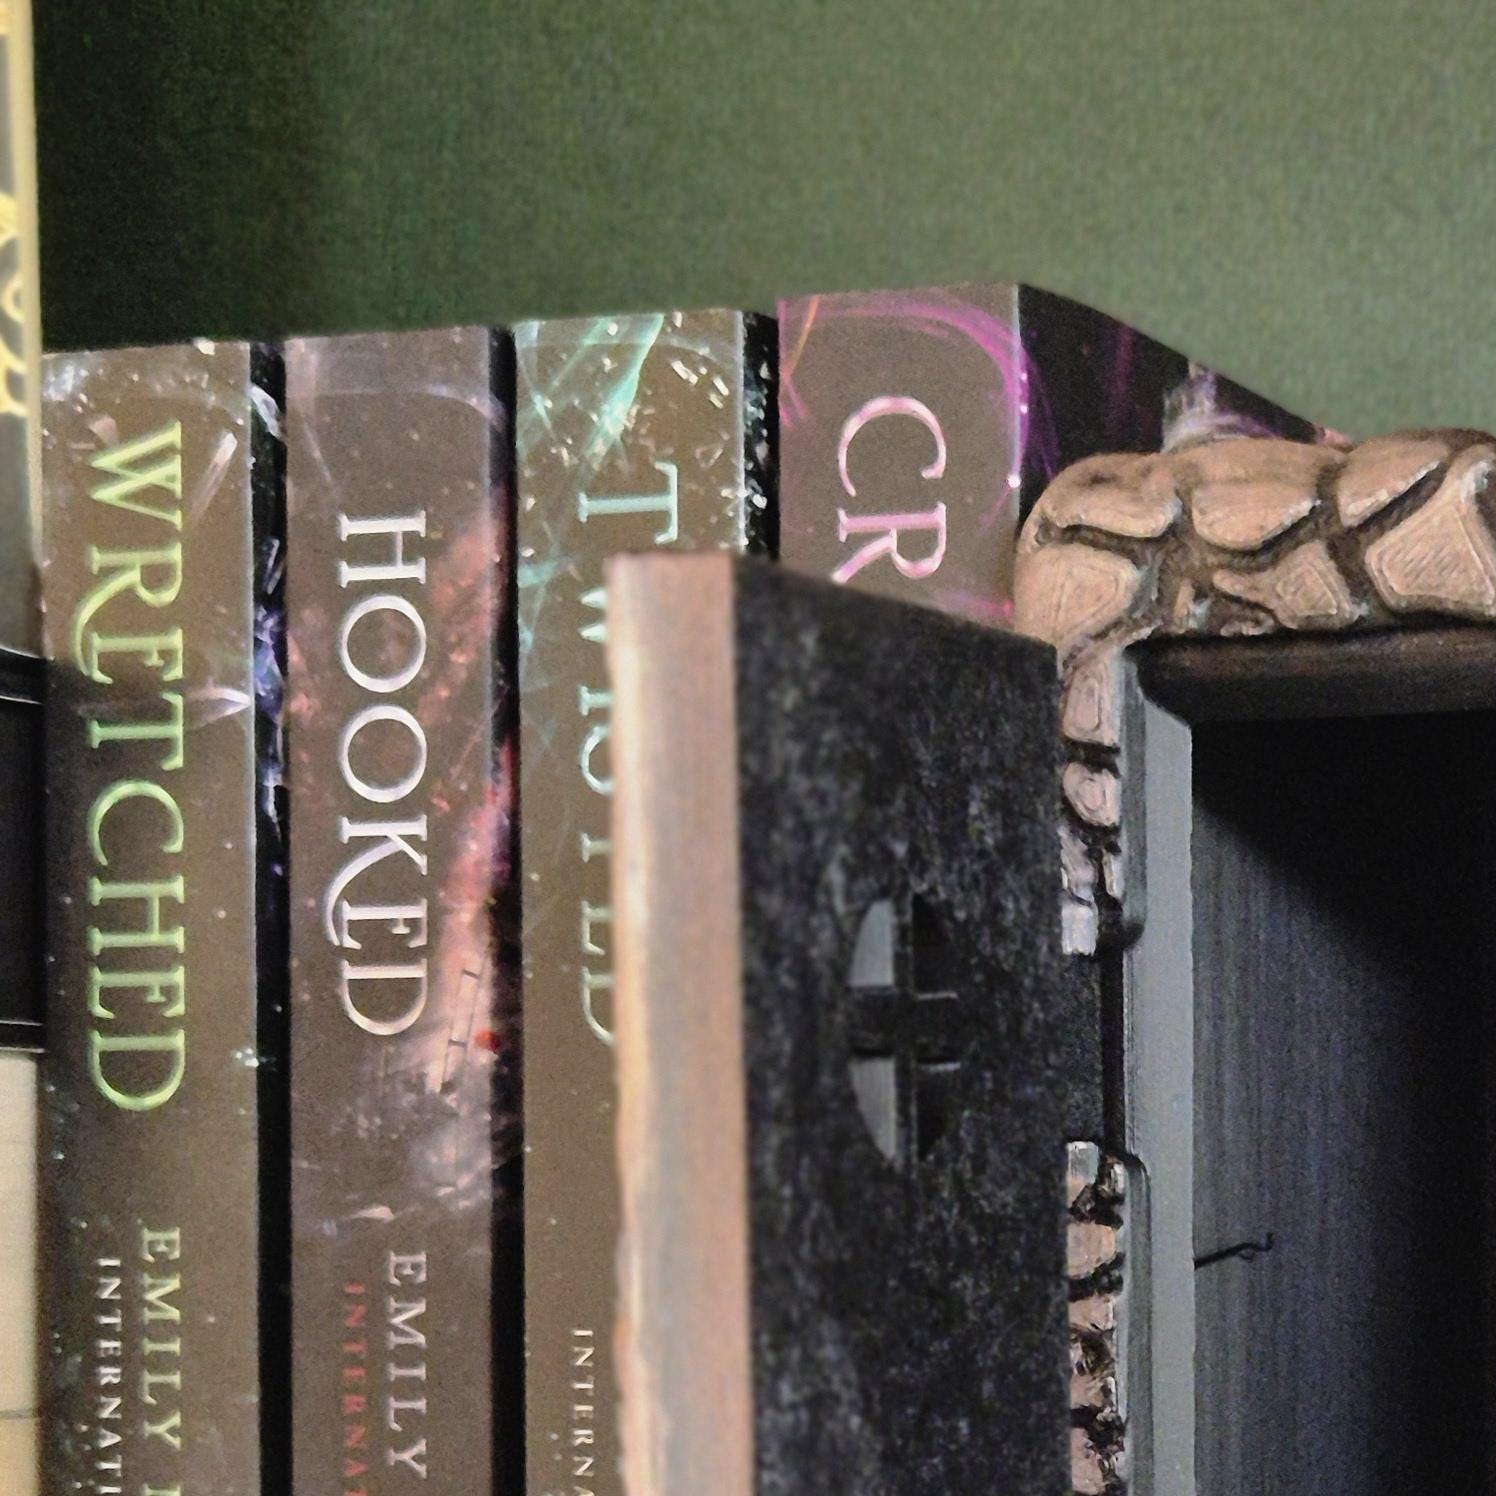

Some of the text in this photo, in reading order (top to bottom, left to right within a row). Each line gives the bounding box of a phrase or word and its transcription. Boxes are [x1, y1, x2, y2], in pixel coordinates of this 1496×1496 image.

[72, 419, 186, 1112] WRETCHED
[325, 510, 429, 1036] HOOKED
[139, 1227, 182, 1449] EMILY
[386, 1250, 427, 1479] EMILY
